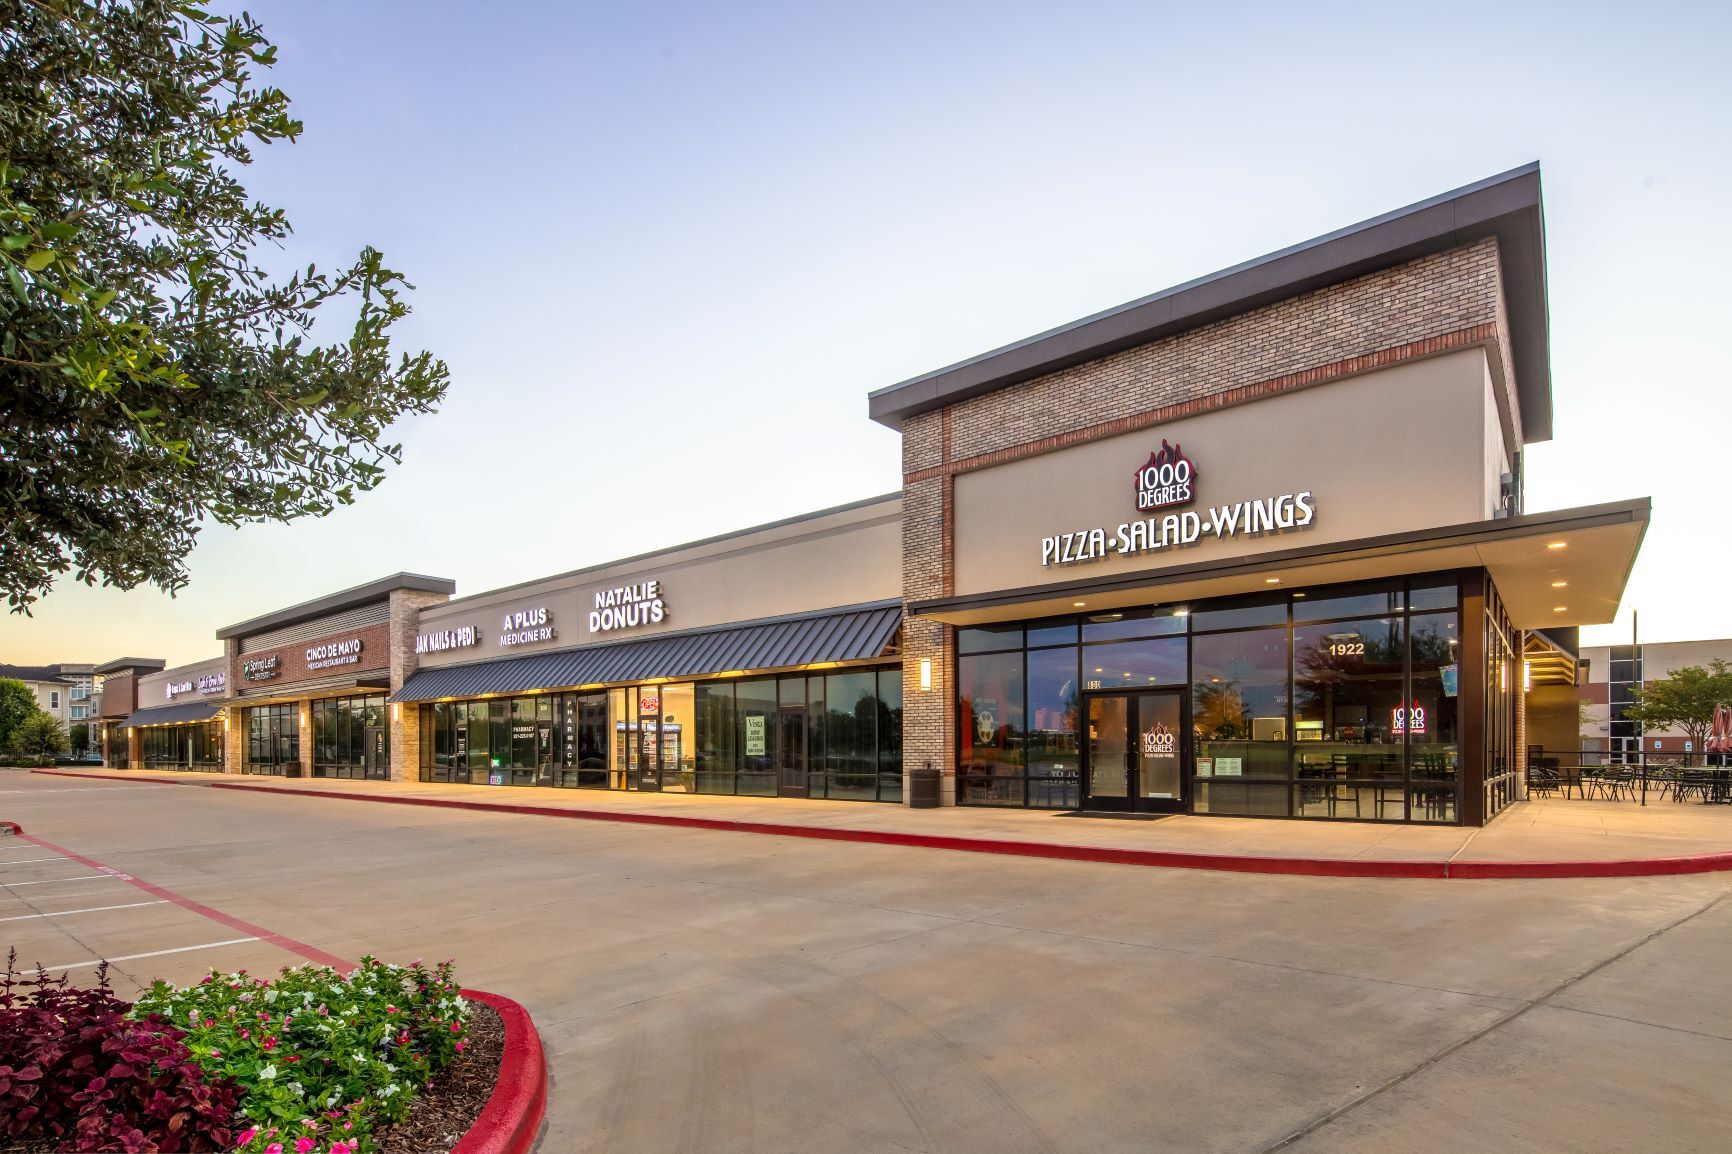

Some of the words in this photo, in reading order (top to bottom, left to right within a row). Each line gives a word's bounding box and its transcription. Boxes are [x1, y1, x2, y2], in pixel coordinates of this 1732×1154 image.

[1139, 460, 1190, 491] 1000
[1139, 481, 1191, 508] DEGREES
[1042, 528, 1105, 566] PIZZA
[1116, 511, 1200, 554] SALAD
[1209, 491, 1313, 538] WINGS
[596, 581, 658, 609] NATALIE
[504, 615, 513, 631] A
[515, 608, 548, 628] PLUS
[589, 600, 665, 633] DONUTS
[416, 636, 428, 654] JAK
[429, 630, 449, 651] NAILS
[450, 632, 456, 647] &
[457, 625, 476, 648] PEDI
[500, 631, 539, 647] MEDICINE
[540, 627, 552, 641] RX
[306, 646, 327, 661] CINCO
[327, 643, 337, 658] DE
[338, 639, 360, 656] MAYO
[1329, 643, 1364, 656] 1922
[250, 659, 264, 673] Spring
[265, 655, 276, 669] Leaf
[566, 700, 574, 767] PHARMACY
[1393, 719, 1424, 729] DEEES
[1143, 733, 1173, 745] 1000
[1145, 744, 1173, 753] DEGREES
